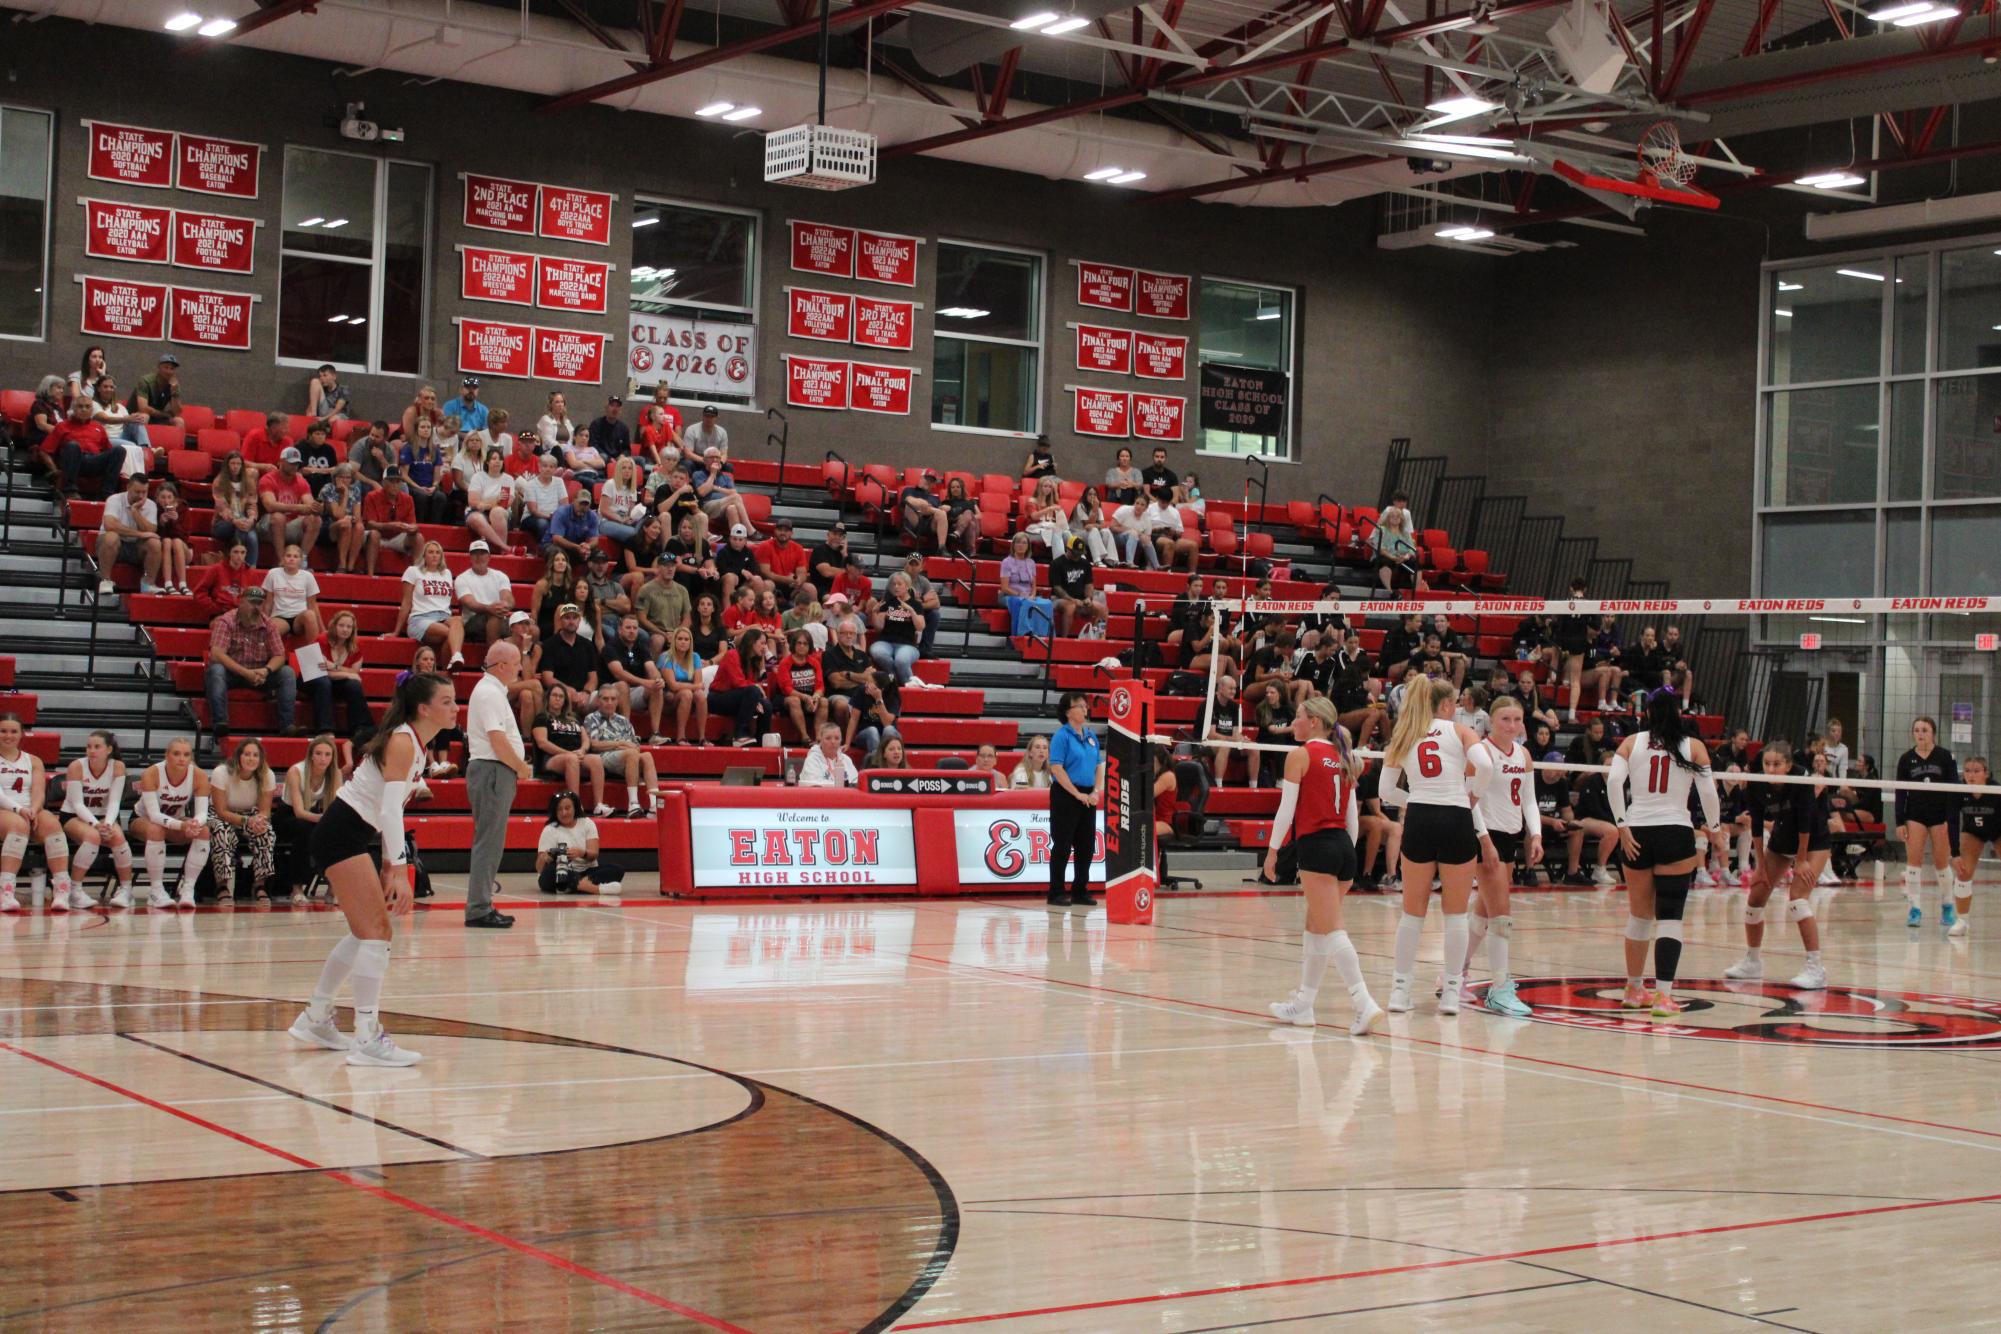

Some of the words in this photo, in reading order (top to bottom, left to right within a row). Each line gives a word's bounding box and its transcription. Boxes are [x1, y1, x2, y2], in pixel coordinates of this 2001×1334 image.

[118, 131, 144, 141] STATE
[100, 134, 163, 159] CHAMPIONS
[206, 144, 230, 153] STATE
[111, 151, 131, 162] 2020
[133, 153, 150, 164] AAA
[188, 146, 248, 170] CHAMPIONS
[113, 161, 147, 172] SOFTBALL
[200, 164, 216, 172] 2021
[219, 166, 234, 176] AAA
[120, 170, 139, 178] EATON
[200, 173, 233, 183] BASEBALL
[207, 181, 225, 189] EATON
[491, 183, 512, 193] STATE
[474, 186, 494, 200] 2ND
[497, 192, 528, 208] PLACE
[567, 193, 587, 202] STATE
[487, 202, 502, 210] 2021
[504, 204, 513, 212] AA
[550, 198, 569, 211] 4TH
[573, 203, 602, 218] PLACE
[116, 209, 141, 218] STATE
[476, 208, 506, 218] MARCHING
[98, 212, 160, 235] CHAMPIONS
[201, 219, 225, 228] STATE
[491, 218, 507, 226] EATON
[575, 222, 593, 230] TRACK
[108, 229, 128, 238] 2020
[131, 231, 147, 240] AAA
[183, 222, 243, 245] CHAMPIONS
[567, 228, 583, 236] EATON
[815, 229, 834, 237] STATE
[107, 238, 148, 248] VOLLEYBALL
[198, 239, 214, 248] 2021
[217, 241, 227, 250] AA
[801, 232, 847, 251] CHAMPIONS
[878, 239, 896, 247] STATE
[117, 246, 136, 255] EATON
[196, 248, 228, 258] FOOTBALL
[864, 241, 908, 260] CHAMPIONS
[202, 256, 220, 264] EATON
[489, 255, 510, 264] STATE
[888, 258, 899, 266] AAA
[472, 258, 526, 278] CHAMPIONS
[564, 264, 585, 272] STATE
[546, 267, 573, 281] THIRD
[576, 272, 602, 287] PLACE
[1084, 271, 1106, 283] FINAL
[1108, 277, 1128, 289] FOUR
[112, 286, 137, 296] STATE
[483, 282, 515, 290] WRESTLING
[1143, 281, 1183, 296] CHAMPIONS
[549, 289, 579, 299] MARCHING
[93, 289, 138, 308] RUNNER
[142, 297, 156, 312] UP
[199, 295, 223, 305] STATE
[812, 296, 830, 304] STATE
[106, 306, 123, 315] 2021
[126, 308, 142, 318] AAA
[181, 299, 211, 316] FINAL
[214, 304, 241, 321] FOUR
[797, 298, 820, 312] FINAL
[822, 304, 844, 318] FOUR
[105, 315, 142, 326] WRESTLING
[193, 315, 210, 324] 2021
[212, 318, 228, 326] AAA
[861, 308, 877, 321] 3RD
[880, 311, 904, 325] PLACE
[113, 324, 131, 332] EATON
[194, 324, 226, 334] SOFTBALL
[486, 327, 507, 336] STATE
[884, 323, 896, 331] AAA
[200, 332, 218, 340] EATON
[469, 330, 523, 350] CHAMPIONS
[559, 335, 580, 343] STATE
[632, 325, 706, 350] CLASS
[718, 335, 749, 354] OF
[542, 337, 595, 358] CHAMPIONS
[1082, 334, 1105, 346] FINAL
[1107, 339, 1127, 350] FOUR
[1138, 342, 1160, 354] FINAL
[1162, 347, 1182, 358] FOUR
[481, 354, 509, 363] BASEBALL
[663, 353, 717, 375] 2026
[554, 361, 581, 370] SOFTBALL
[809, 363, 828, 371] STATE
[794, 366, 841, 384] CHAMPIONS
[856, 373, 882, 386] FINAL
[884, 378, 905, 391] FOUR
[1224, 377, 1263, 390] EATON
[1202, 387, 1233, 397] HIGH
[1238, 391, 1284, 404] SCHOOL
[1082, 397, 1123, 413] CHAMPIONS
[1137, 402, 1158, 414] FINAL
[1160, 406, 1178, 419] FOUR
[1215, 401, 1250, 412] CLASS
[1255, 405, 1270, 415] OF
[309, 457, 328, 468] GO
[1256, 602, 1286, 611] EATON
[1288, 602, 1314, 611] REDS
[1360, 601, 1393, 612] EATON
[1395, 602, 1424, 612] REDS
[1474, 601, 1512, 612] EATON
[1514, 601, 1545, 612] REDS
[1600, 601, 1640, 612] EATON
[1643, 601, 1678, 612] REDS
[1738, 600, 1783, 612] EATON
[1786, 600, 1825, 611] REDS
[1891, 598, 1942, 611] EATON
[1944, 598, 1988, 610] REDS
[1978, 635, 1994, 649] EXIT
[1417, 741, 1442, 778] 6
[1648, 755, 1670, 793] 11
[12, 777, 23, 793] 4
[920, 781, 940, 791] POSS
[1334, 774, 1340, 815] 1
[1510, 778, 1522, 806] 8
[1106, 756, 1120, 854] EATON
[1121, 778, 1130, 832] REDS
[777, 812, 818, 822] Welcome
[821, 812, 829, 822] to
[1030, 814, 1050, 823] Hom
[1974, 817, 1983, 826] 5
[729, 828, 879, 866] EATON
[739, 872, 788, 884] HIGH
[800, 871, 875, 883] SCHOOL
